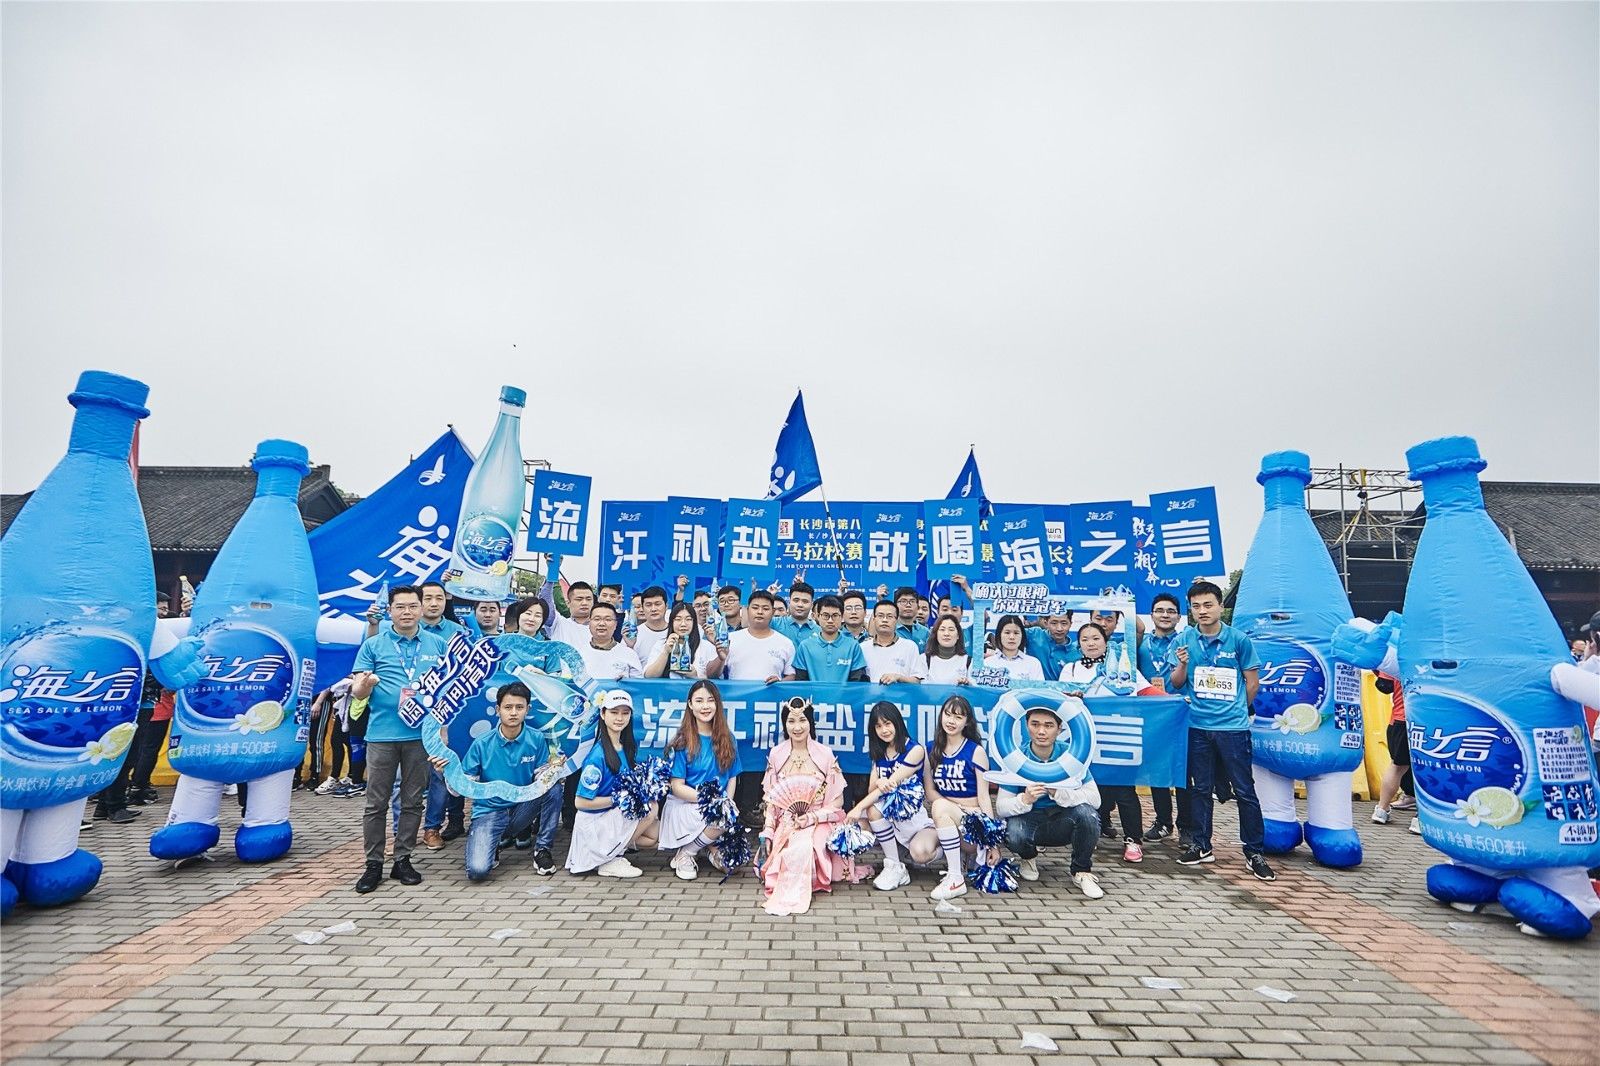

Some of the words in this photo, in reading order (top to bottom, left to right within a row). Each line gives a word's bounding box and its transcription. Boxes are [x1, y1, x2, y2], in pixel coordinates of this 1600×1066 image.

[536, 497, 581, 542] 流
[611, 530, 648, 571] 汗
[672, 523, 711, 564] 补
[730, 525, 770, 566] 盐
[776, 542, 863, 561] 马拉松赛
[868, 531, 909, 573] 就
[932, 525, 974, 566] 喝
[999, 537, 1045, 582] 海
[1080, 531, 1128, 574] 之
[1160, 519, 1213, 565] 言
[975, 584, 1048, 600] 确认过眼神
[992, 599, 1067, 615] 你就是冠军
[0, 664, 140, 703] 海之言
[202, 685, 221, 693] SALT
[234, 684, 265, 692] LEMON
[37, 706, 69, 714] SALT
[87, 704, 122, 713] LEMON
[1445, 763, 1482, 773] LEMON
